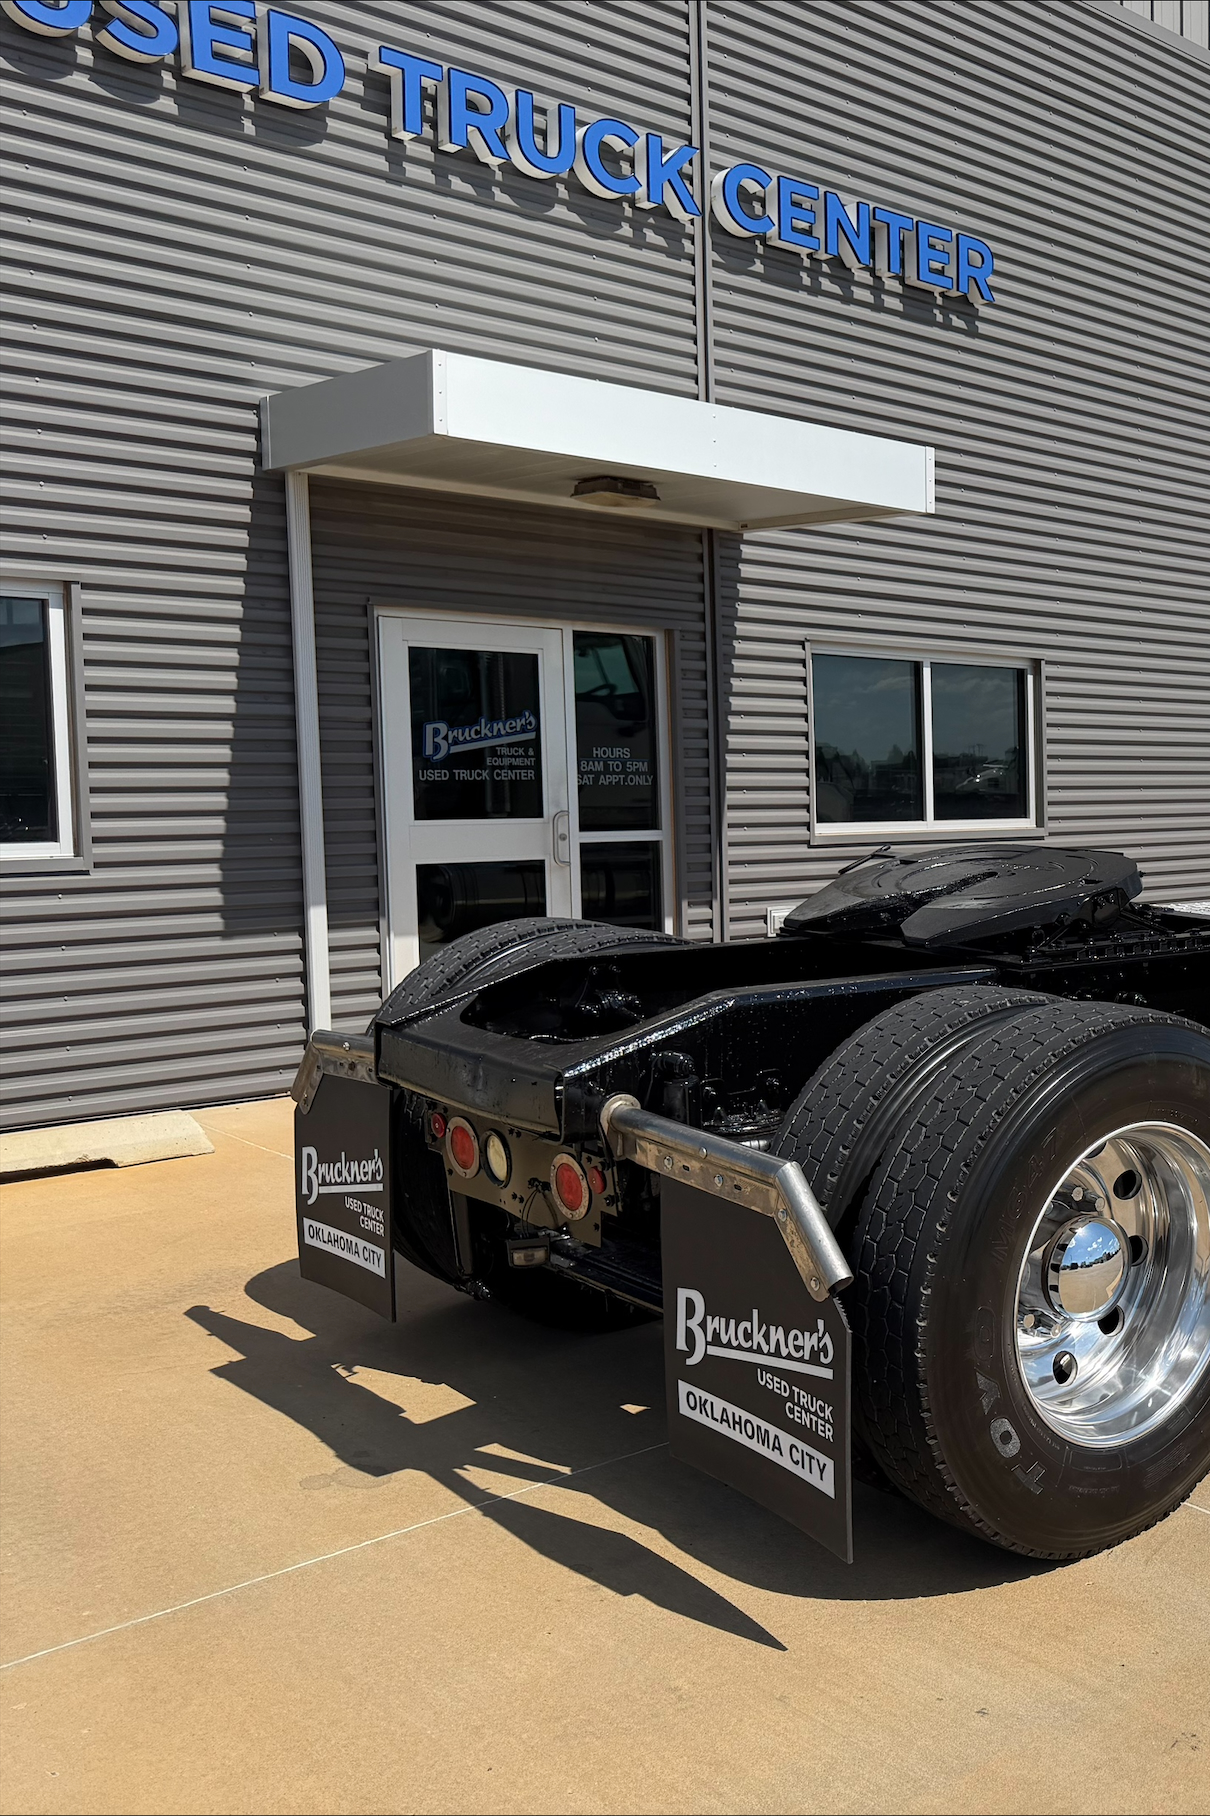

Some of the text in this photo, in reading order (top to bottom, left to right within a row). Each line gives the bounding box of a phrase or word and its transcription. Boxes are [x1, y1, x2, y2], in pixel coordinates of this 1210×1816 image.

[370, 45, 701, 219] TRUCK
[711, 162, 996, 304] CENTER
[424, 710, 537, 762] Bruckner's
[496, 747, 534, 756] TRUCK &
[593, 747, 631, 759] HOURS
[419, 769, 535, 781] USED TRUCK CENTER
[487, 757, 536, 766] EQUIPMENT
[577, 774, 594, 786] SAT
[580, 761, 648, 772] 8AM TO 5PM
[301, 1146, 384, 1205] Bruckner's
[344, 1196, 385, 1223] USED TRUCK
[359, 1215, 385, 1237] CENTER
[308, 1224, 382, 1268] OKLAHOMA CITY
[676, 1287, 834, 1365] Bruckner's
[757, 1368, 834, 1423] USED TRUCK
[974, 1304, 1047, 1496] TOYO
[685, 1390, 827, 1482] OKLAHOMA CITY
[785, 1402, 834, 1443] CENTER
